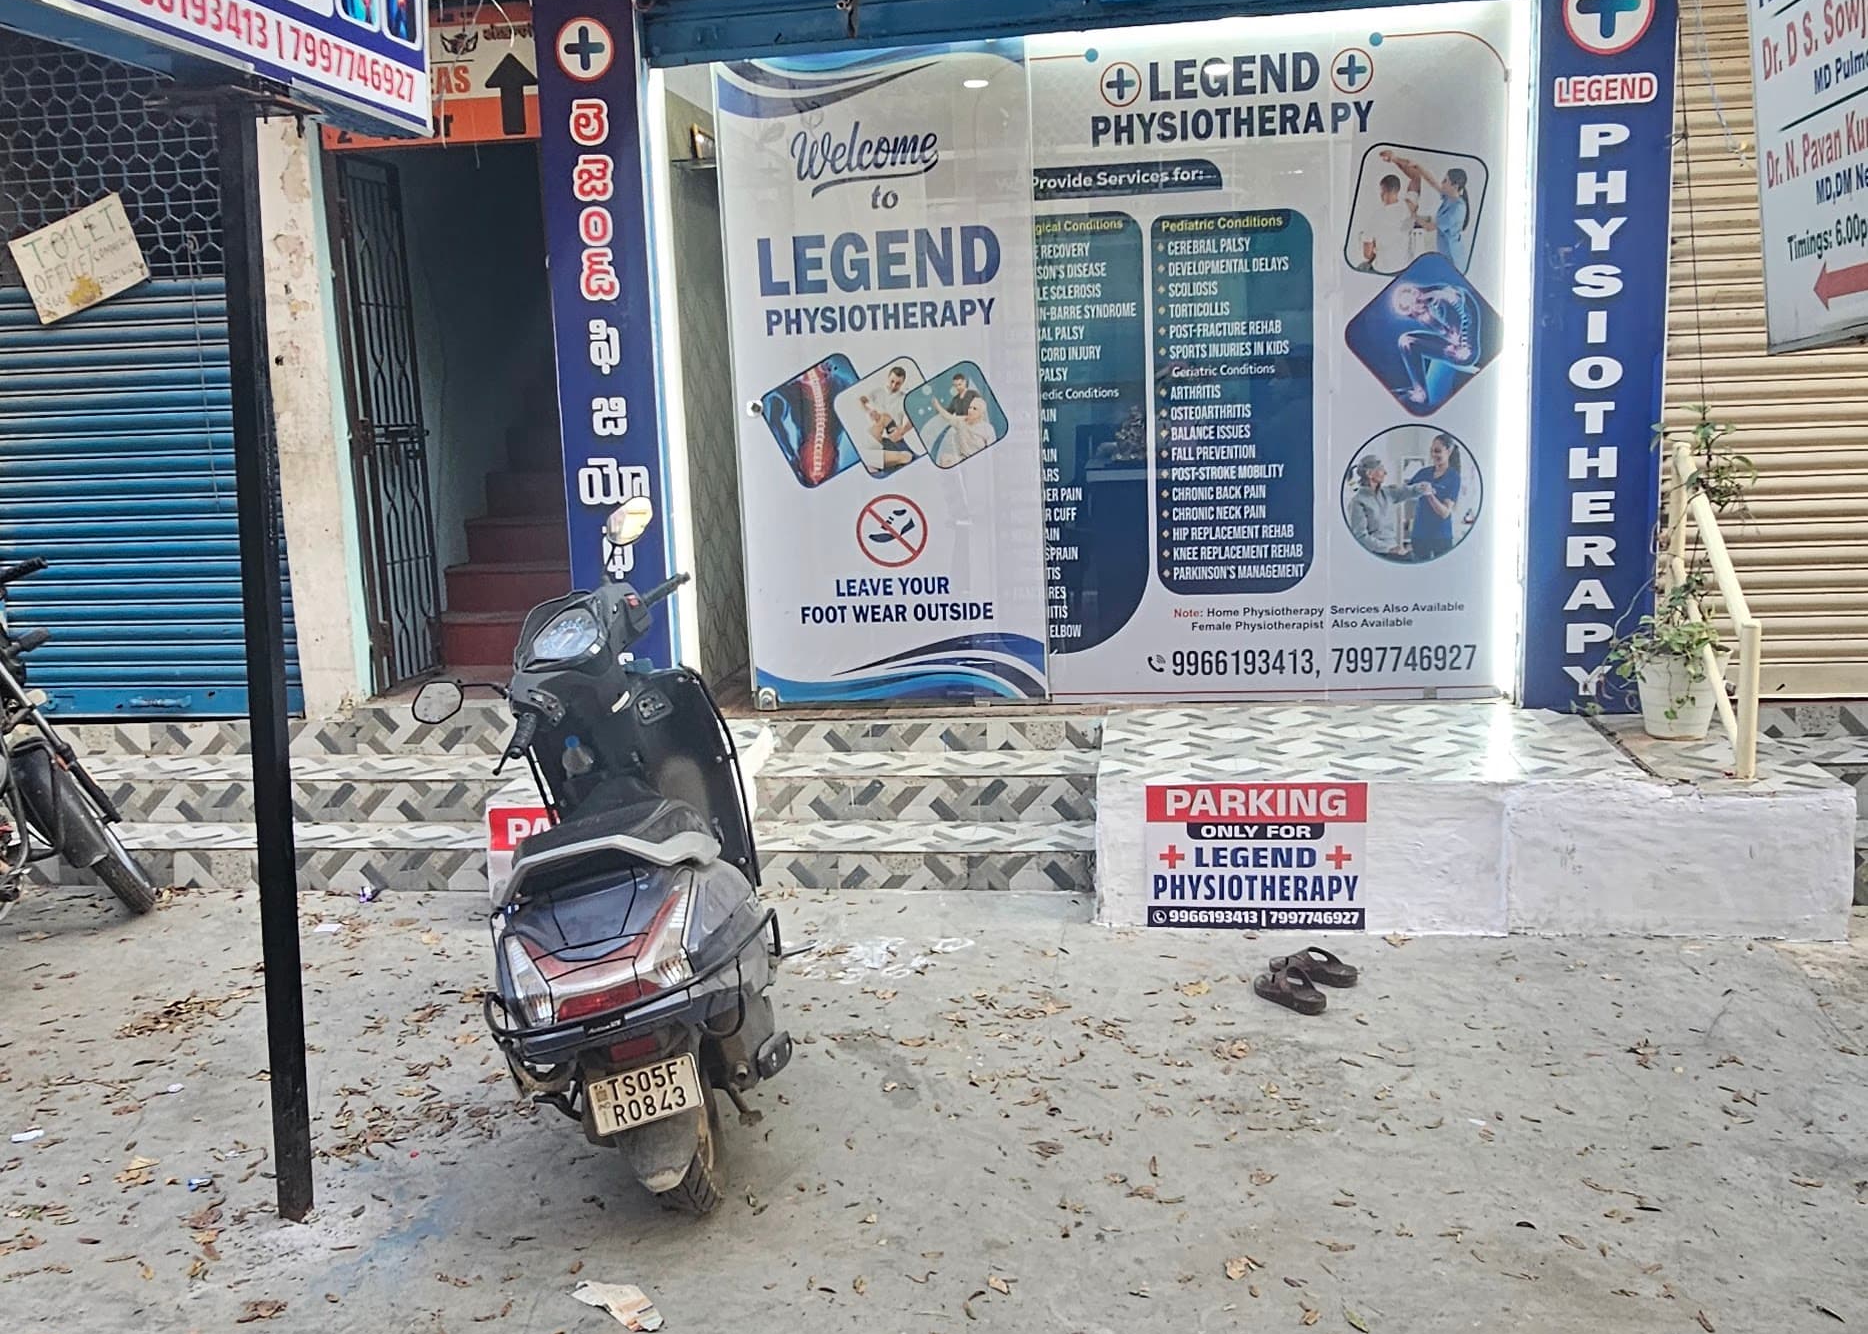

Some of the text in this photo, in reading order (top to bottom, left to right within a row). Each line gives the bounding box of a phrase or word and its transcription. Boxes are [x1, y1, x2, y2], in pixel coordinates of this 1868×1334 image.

[1762, 9, 1819, 81] Dr. D S.
[291, 25, 415, 105] 7997746927
[1149, 51, 1320, 103] LEGEND
[1813, 65, 1832, 96] MD
[1553, 73, 1657, 108] LEGEND
[1091, 100, 1375, 148] PHYSIOTHERAPY
[790, 120, 939, 183] Welcome
[1766, 128, 1843, 190] Dr. N. Pavan
[1033, 166, 1204, 191] Provide Services for:
[871, 184, 899, 210] to
[1063, 217, 1123, 233] Conditions
[1161, 214, 1283, 233] Pediatric Conditions
[1040, 242, 1091, 259] RECOVERY
[1168, 236, 1251, 256] CEREBRAL PALSY
[1787, 229, 1834, 264] Timings:
[757, 224, 1002, 300] LEGEND
[1067, 261, 1107, 278] DISEASE
[1168, 256, 1289, 277] DEVELOPMENTAL DELAYS
[1050, 283, 1102, 300] SCLEROSIS
[1168, 281, 1218, 298] SCOLIOSIS
[765, 297, 996, 338] PHYSIOTHERAPY
[1083, 301, 1137, 319] SYNDROME
[1169, 301, 1230, 319] TORTICOLLIS
[1055, 324, 1085, 341] PALSY
[1169, 318, 1282, 340] POST-FRACTURE REHAB
[1040, 345, 1102, 362] CORD INJURY
[1169, 338, 1290, 361] SPORTS INJURIES IN KIDS
[1040, 367, 1069, 383] PALSY
[1172, 363, 1275, 379] Geriatric Conditions
[1065, 386, 1120, 401] Conditions
[1170, 384, 1222, 401] ARTHRITIS
[1170, 403, 1252, 421] OSTEOARTHRITIS
[1561, 123, 1631, 697] PHYSIOTHERAPY
[1171, 424, 1251, 442] BALANCE ISSUES
[1171, 443, 1256, 462] FALL PREVENTION
[1172, 463, 1285, 482] POST-STROKE MOBILITY
[1060, 486, 1082, 502] PAIN
[1172, 484, 1266, 503] CHRONIC BACK PAIN
[1053, 506, 1077, 522] CUFF
[1172, 504, 1266, 522] CHRONIC NECK PAIN
[1173, 523, 1295, 542] HIP REPLACEMENT REHAB
[1045, 546, 1079, 561] SPRAIN
[1173, 542, 1304, 562] KNEE REPLACEMENT REHAB
[1173, 563, 1305, 581] PARKINSON'S MANAGEMENT
[834, 574, 950, 600] LEAVE YOUR
[799, 599, 995, 627] FOOT WEAR OUTSIDE
[1173, 600, 1465, 620] Note: Home Physiotherapy Services Also Available
[1050, 624, 1082, 639] ELBOW
[1191, 616, 1413, 633] Female Physiotherapist Also Available
[1172, 644, 1477, 679] 9966193413, 7997746927
[1165, 787, 1348, 817] PARKING
[1200, 824, 1312, 839] ONLY FOR
[1194, 846, 1318, 868] LEGEND
[1153, 873, 1359, 902] PHYSIOTHERAPY
[1168, 908, 1360, 927] 9966193413 7997746927
[607, 1060, 678, 1102] TS05F
[613, 1085, 687, 1127] R0843
